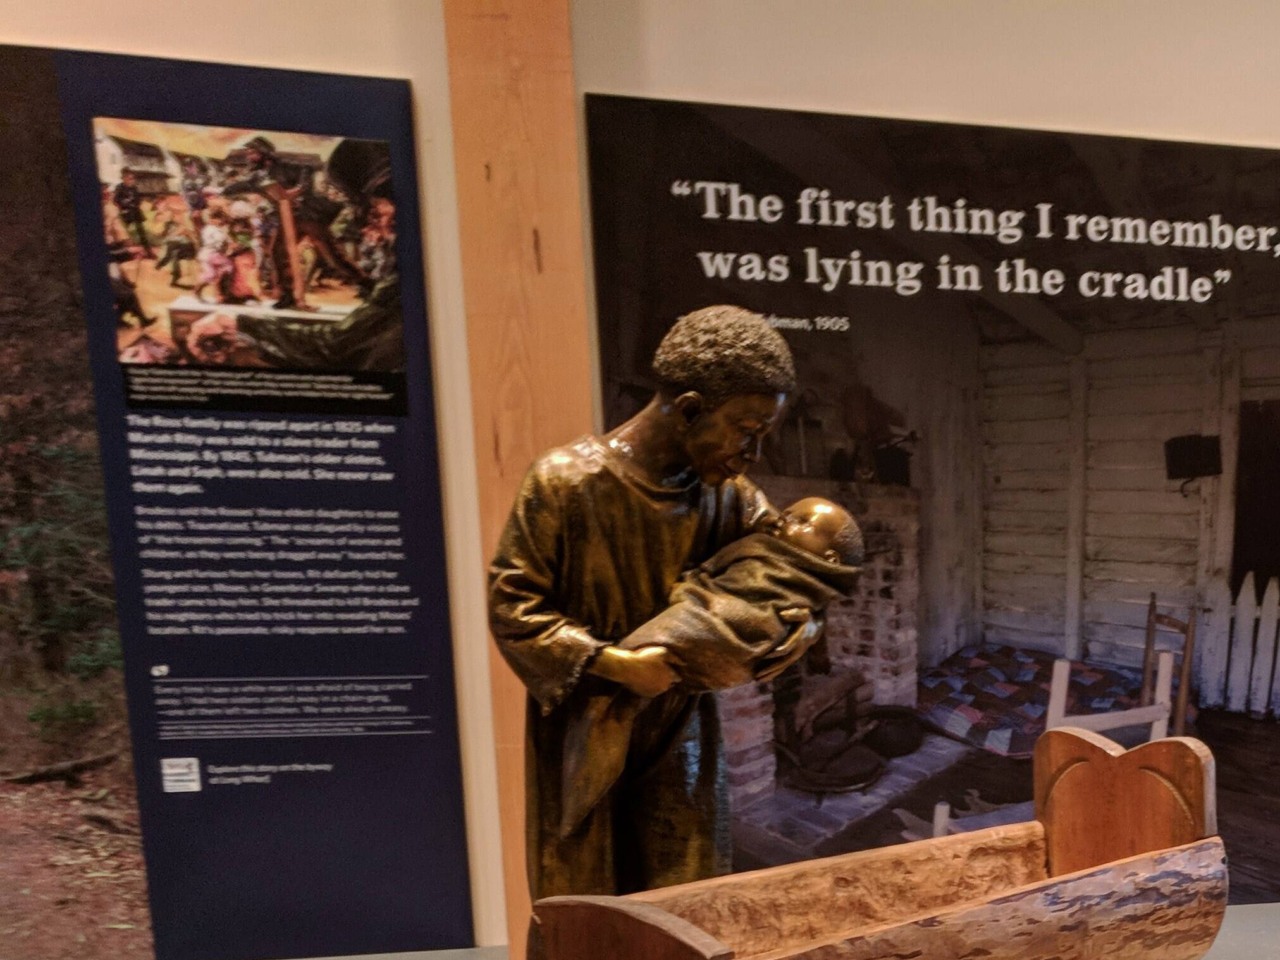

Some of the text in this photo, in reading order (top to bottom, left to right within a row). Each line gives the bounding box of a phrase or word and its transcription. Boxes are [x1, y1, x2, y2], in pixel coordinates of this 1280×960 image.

[671, 181, 784, 223] “The
[797, 187, 895, 230] first
[907, 195, 1025, 244] thing
[1035, 203, 1054, 238] I
[697, 247, 1231, 303] was lying in the cradle”
[814, 316, 851, 331] 1905
